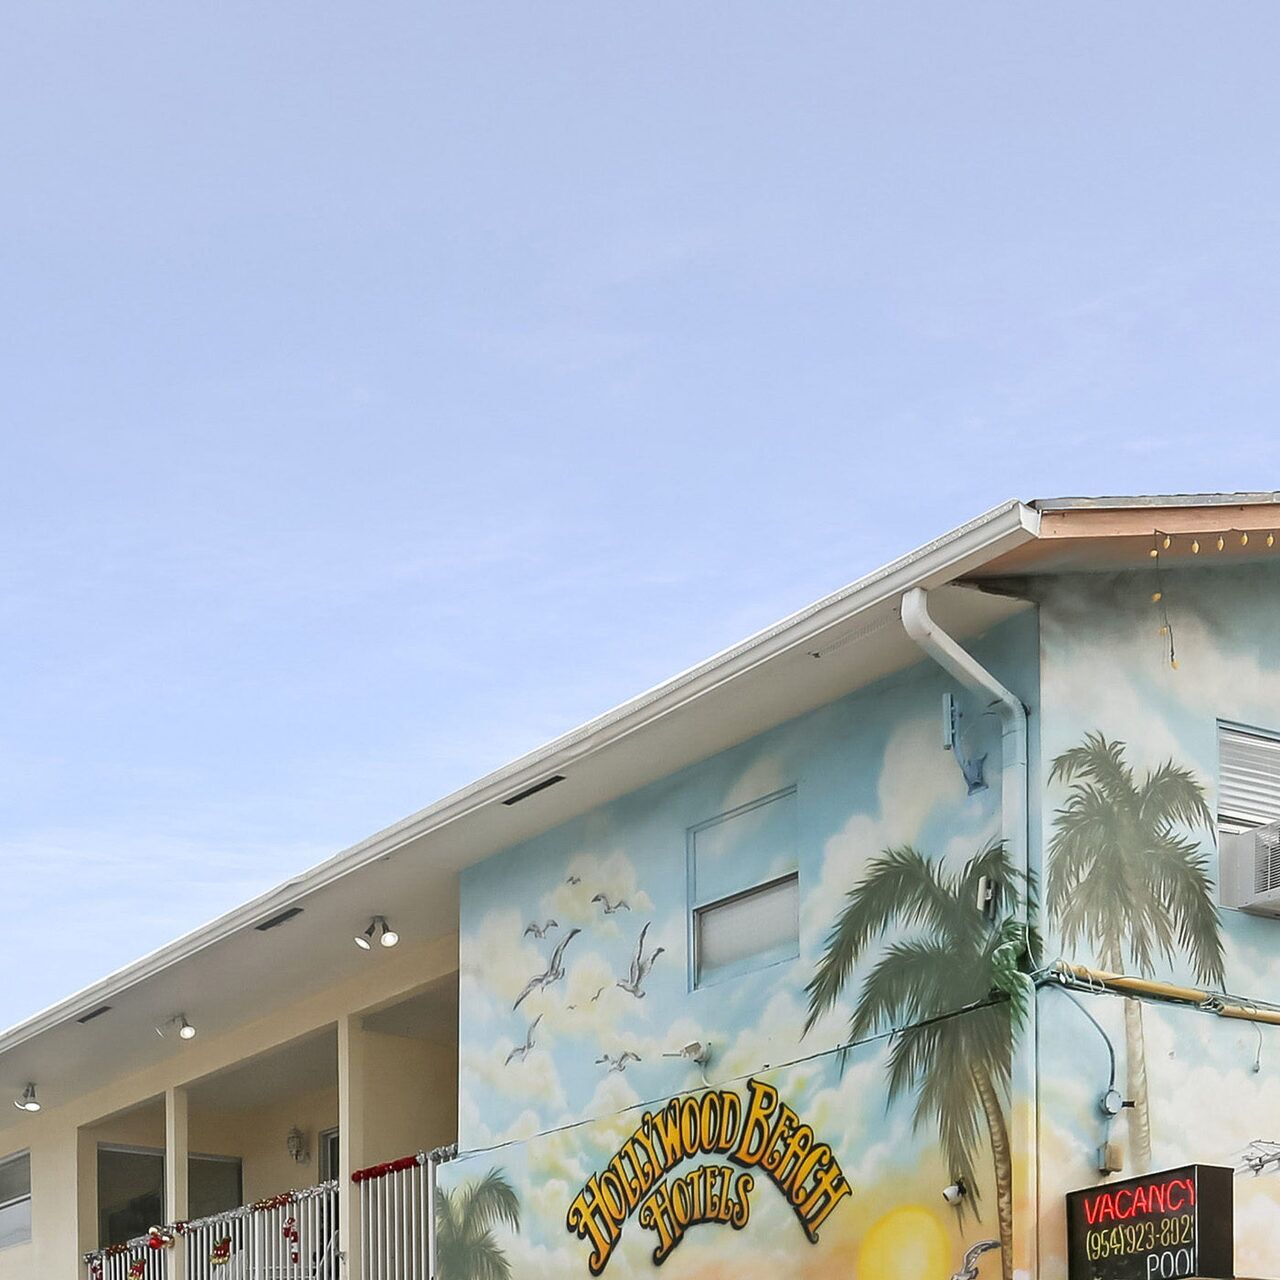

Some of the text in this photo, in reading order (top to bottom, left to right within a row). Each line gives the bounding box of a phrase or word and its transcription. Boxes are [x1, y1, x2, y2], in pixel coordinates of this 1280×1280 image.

[567, 1078, 853, 1277] HOLLYWOOD BEACH
[1084, 1178, 1195, 1225] VACANCY
[639, 1165, 755, 1266] HOTELS
[1086, 1214, 1194, 1261] (954)923-802
